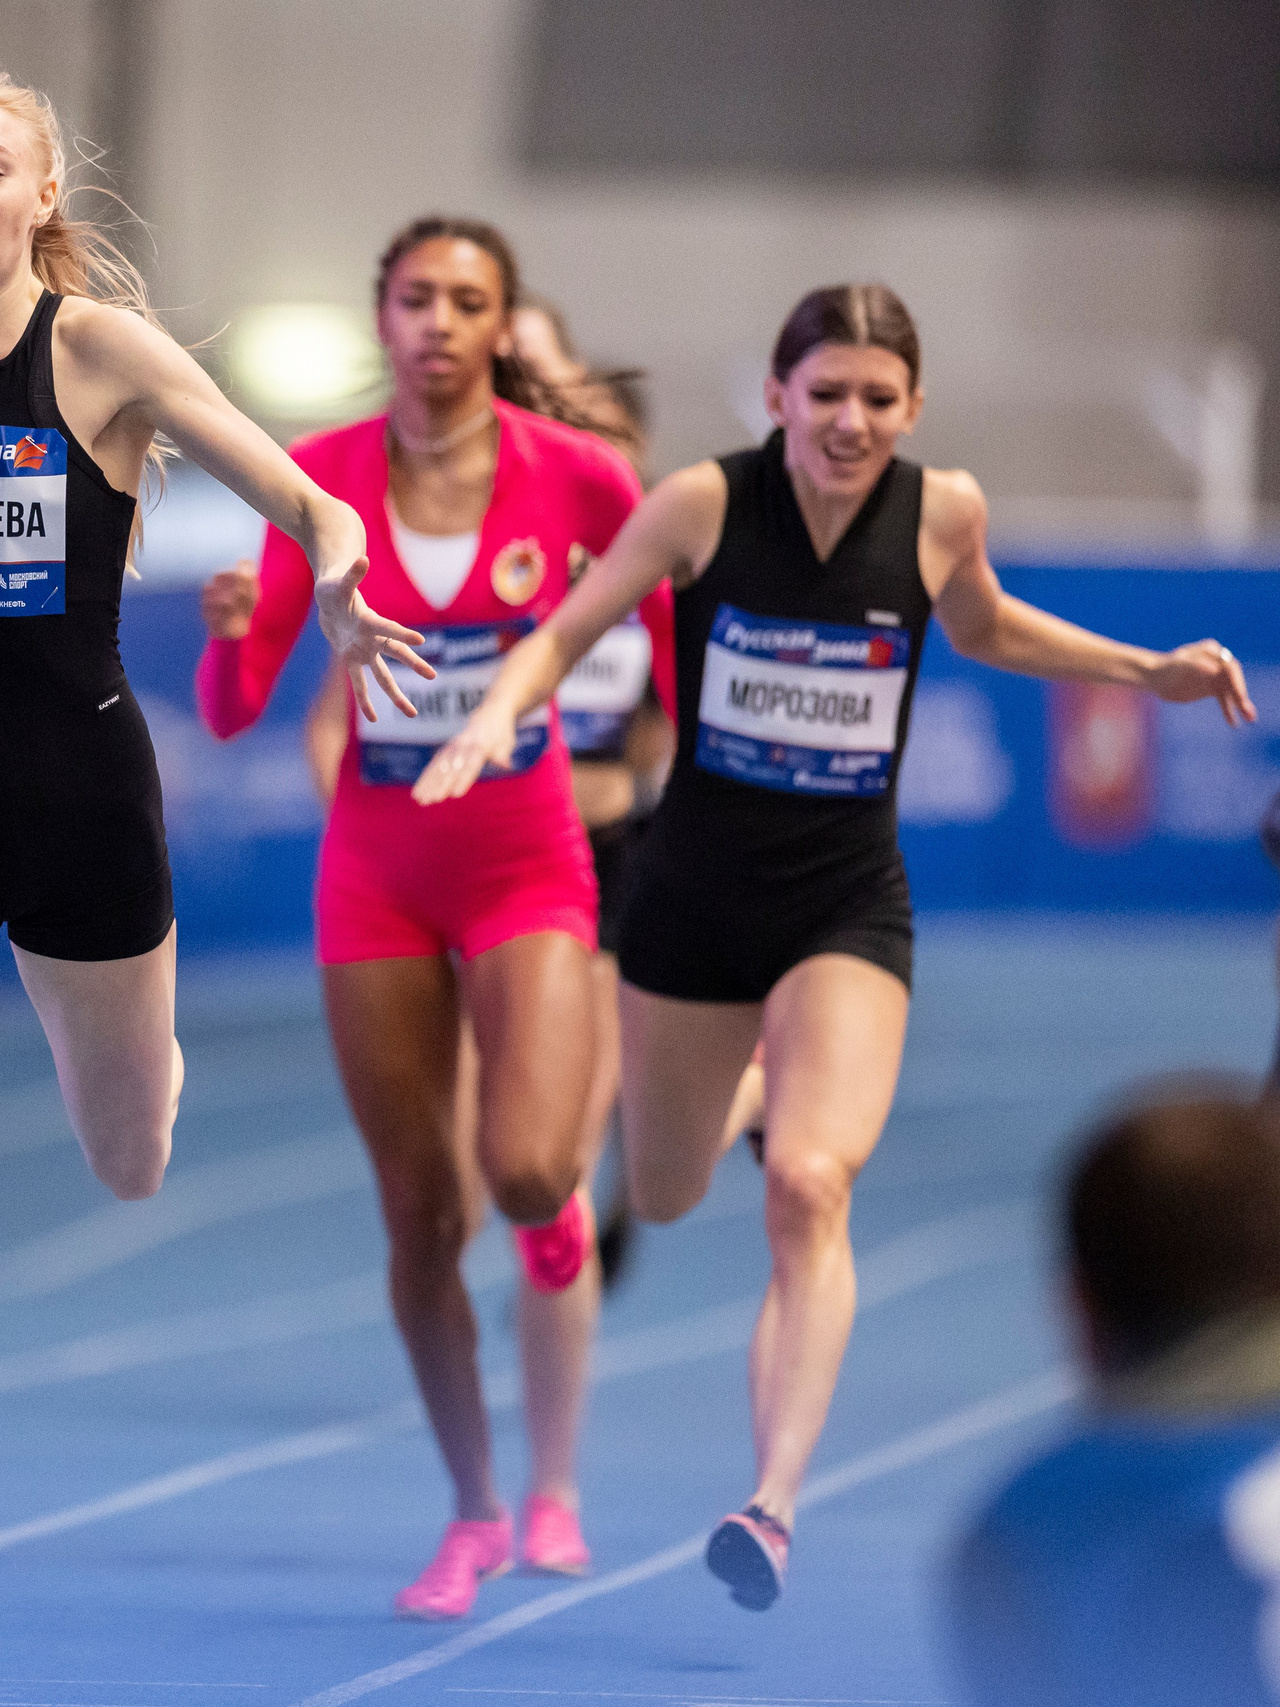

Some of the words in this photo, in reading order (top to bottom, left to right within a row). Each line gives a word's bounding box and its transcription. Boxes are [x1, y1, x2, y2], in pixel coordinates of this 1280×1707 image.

[8, 570, 48, 581] МОСКОВСКИЙ
[8, 580, 27, 589] СПОРТ
[729, 677, 872, 726] МОРОЗОВА
